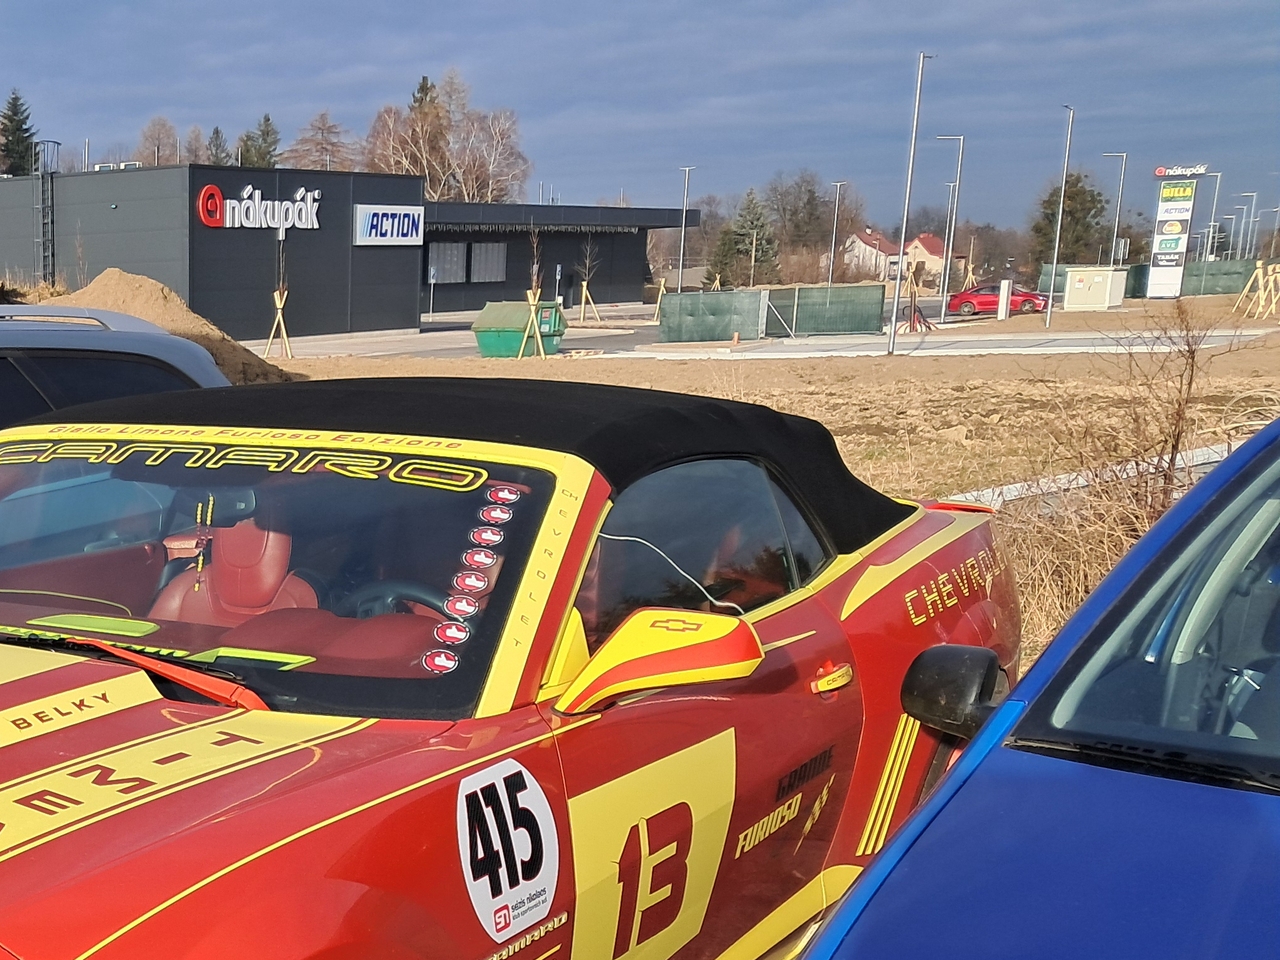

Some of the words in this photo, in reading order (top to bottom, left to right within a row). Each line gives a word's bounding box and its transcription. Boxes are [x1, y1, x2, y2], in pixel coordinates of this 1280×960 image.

[1162, 187, 1192, 197] BILLA
[1163, 207, 1191, 215] ACTION
[368, 212, 421, 238] ACTION
[48, 426, 111, 434] Giallo
[117, 426, 205, 437] Limone
[214, 429, 320, 440] Furioso
[10, 691, 112, 732] BELKY
[465, 770, 545, 900] 415
[735, 791, 803, 860] FURIOSO
